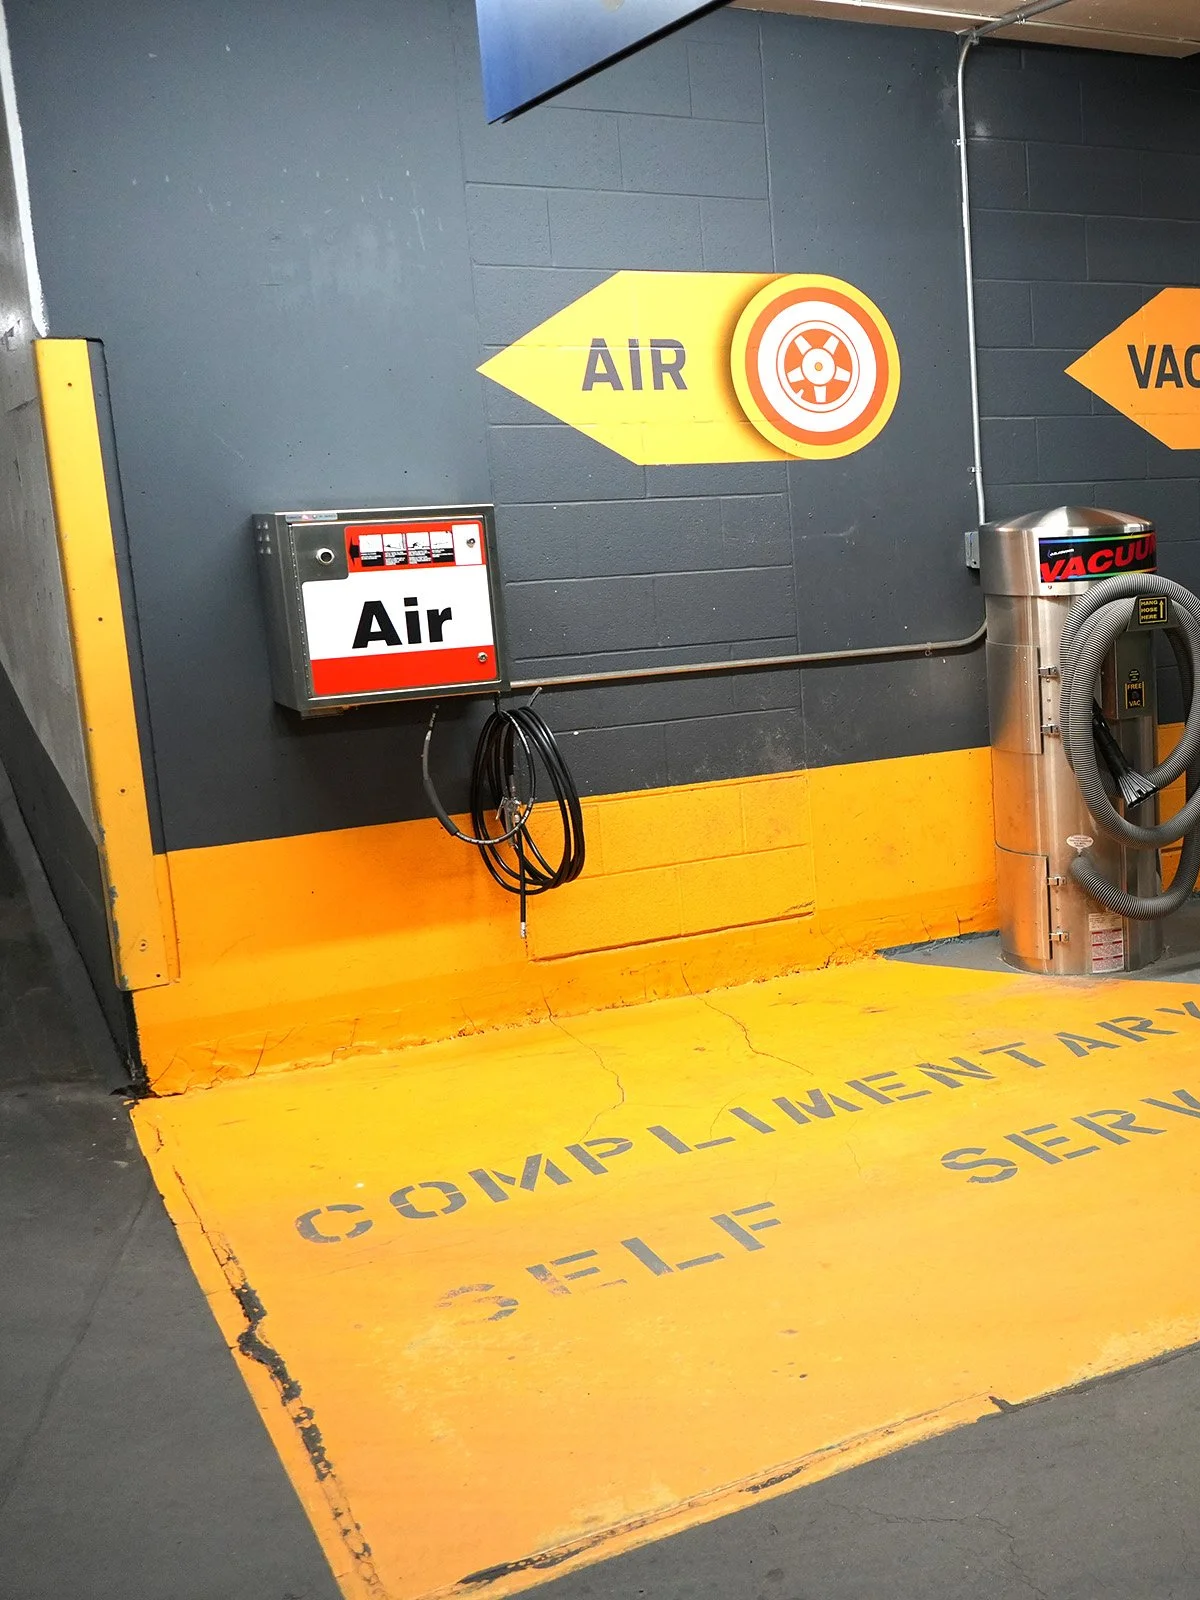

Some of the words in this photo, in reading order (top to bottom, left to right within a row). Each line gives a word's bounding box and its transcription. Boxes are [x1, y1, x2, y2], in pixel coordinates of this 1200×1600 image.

[582, 338, 688, 391] AIR
[352, 597, 453, 649] Air
[434, 1200, 783, 1326] SELF
